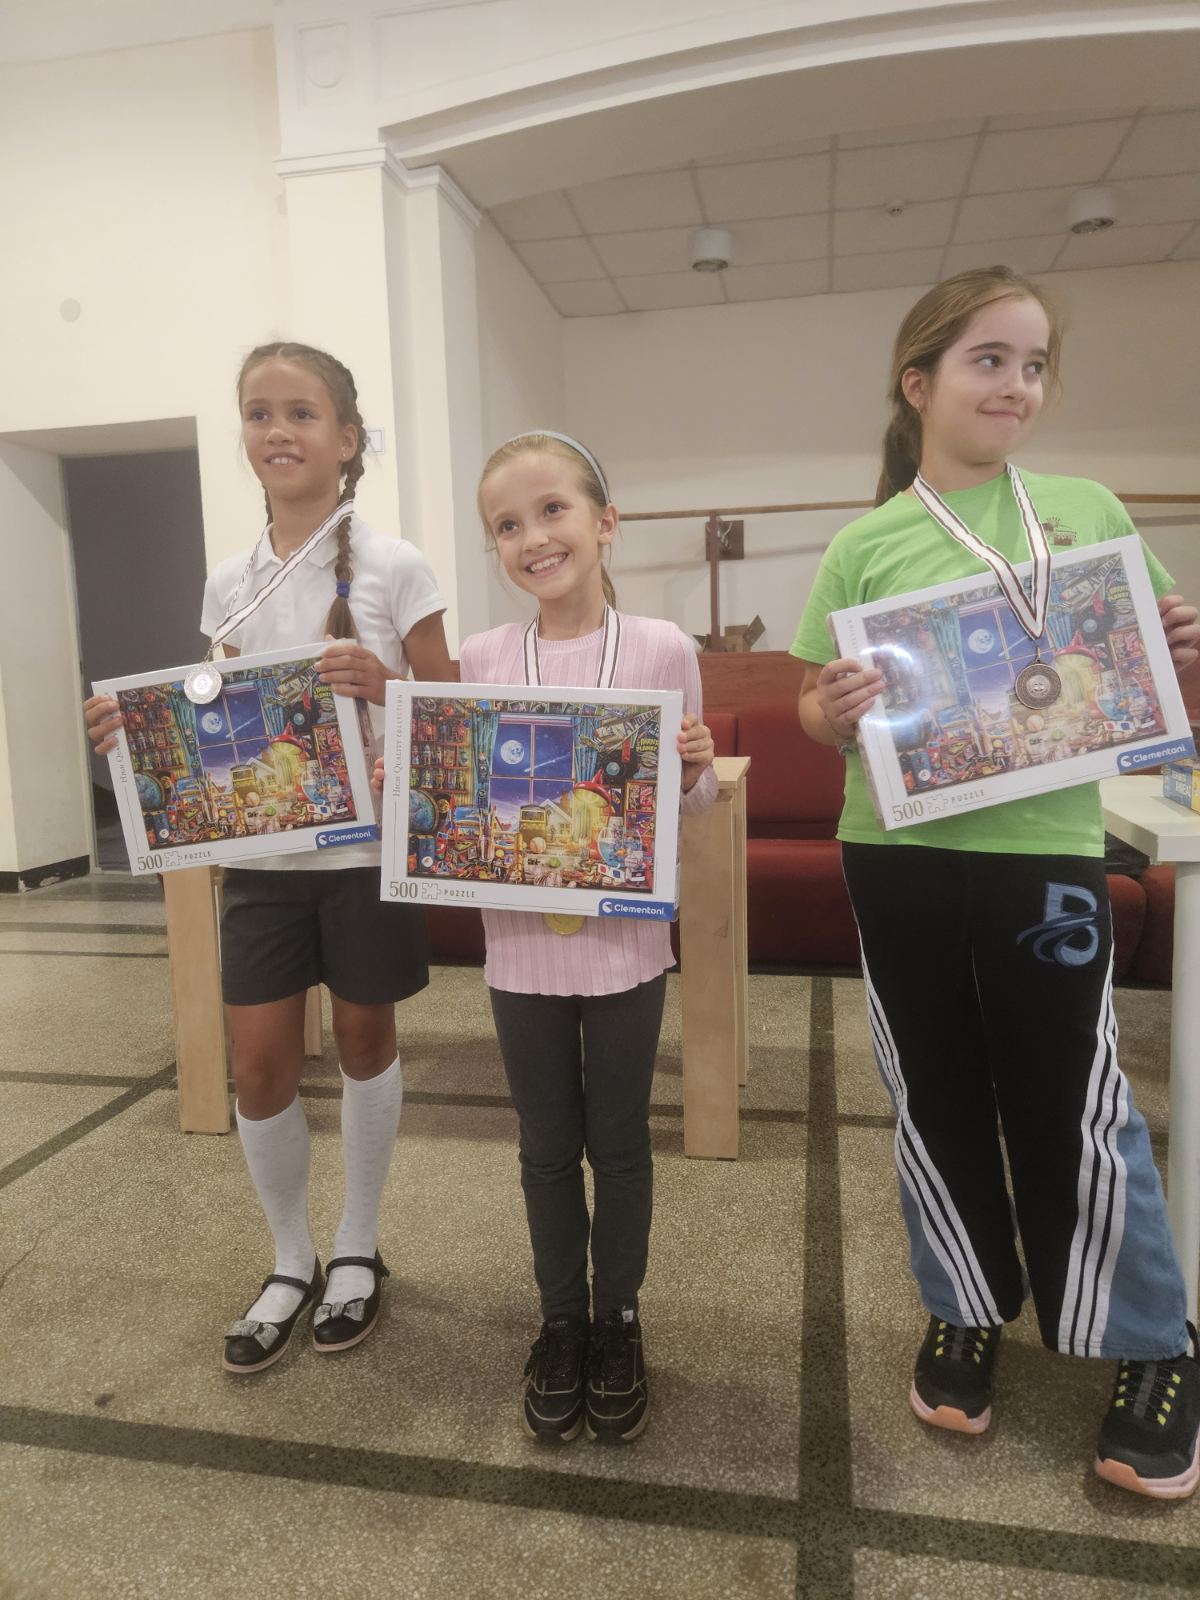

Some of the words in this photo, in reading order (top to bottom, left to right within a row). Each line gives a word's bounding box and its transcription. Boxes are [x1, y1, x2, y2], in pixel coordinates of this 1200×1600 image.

[1132, 743, 1186, 763] Clementoni
[892, 800, 924, 822] 500
[951, 789, 985, 804] PUZZLE
[328, 829, 371, 843] Clementoni
[137, 854, 163, 871] 500
[184, 850, 212, 860] PUZZLE
[389, 881, 418, 898] 500
[444, 889, 476, 898] PUZZLE
[614, 903, 665, 915] Clementoni
